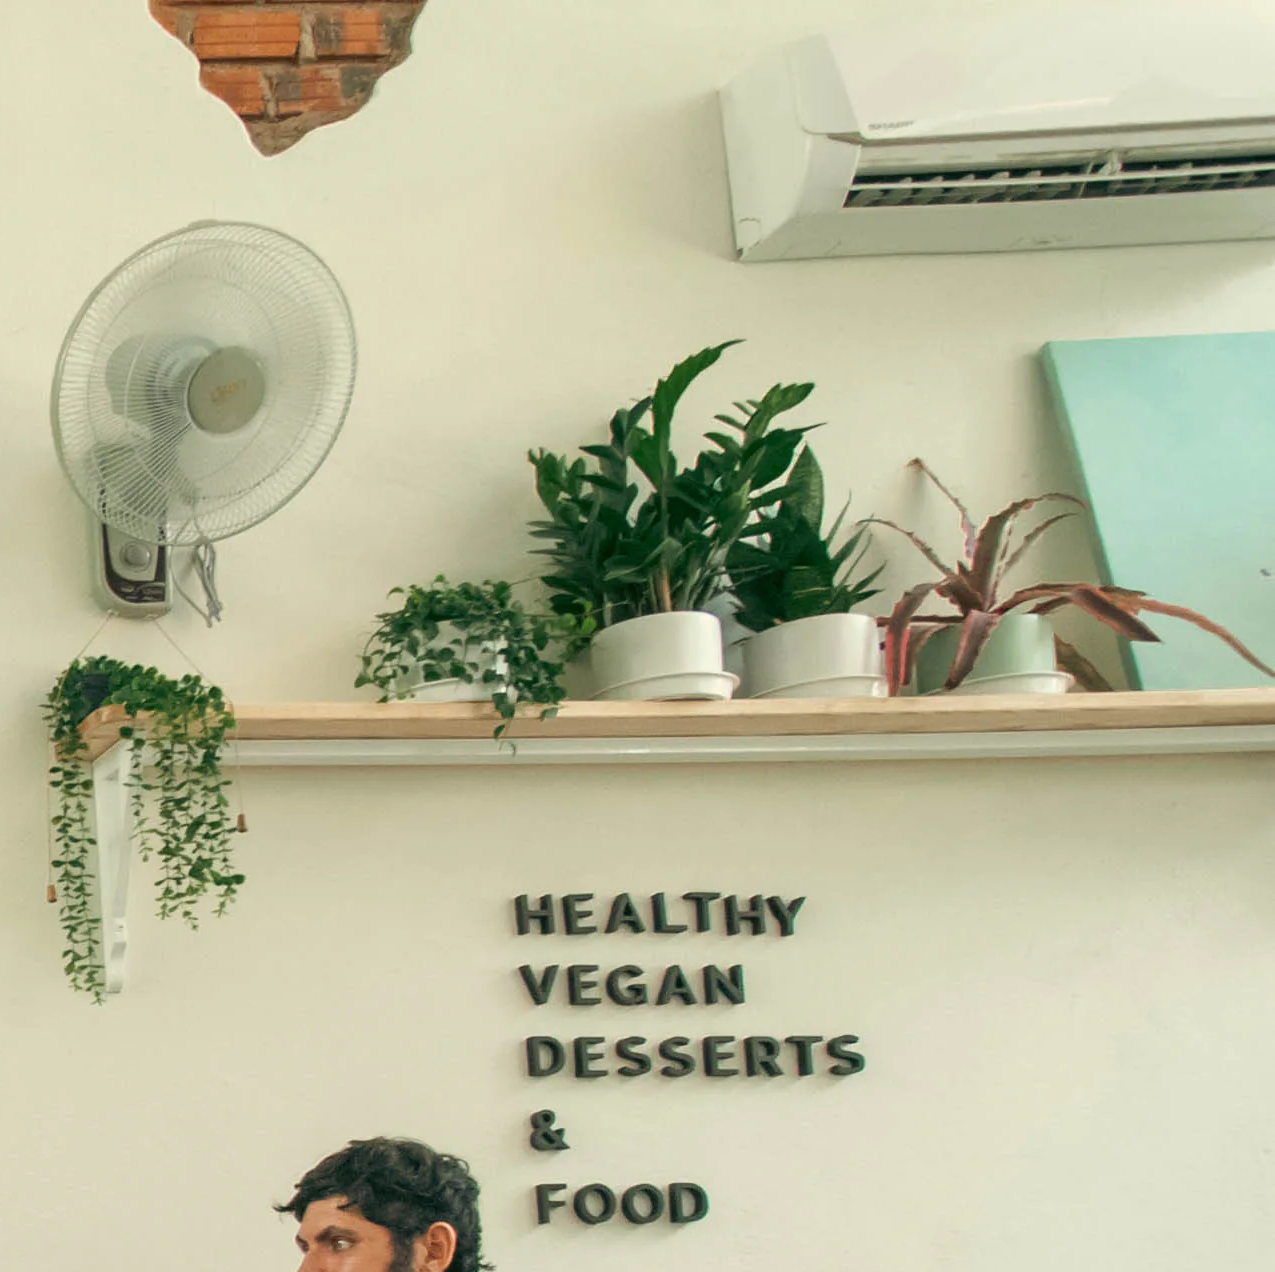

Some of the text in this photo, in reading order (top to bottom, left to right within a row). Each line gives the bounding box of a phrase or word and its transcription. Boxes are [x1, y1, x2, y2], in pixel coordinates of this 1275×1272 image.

[514, 891, 807, 937] HEALTHY
[518, 964, 746, 1006] VEGAN
[525, 1034, 866, 1077] DESSERTS
[529, 1109, 571, 1151] &
[534, 1182, 710, 1225] FOOD
